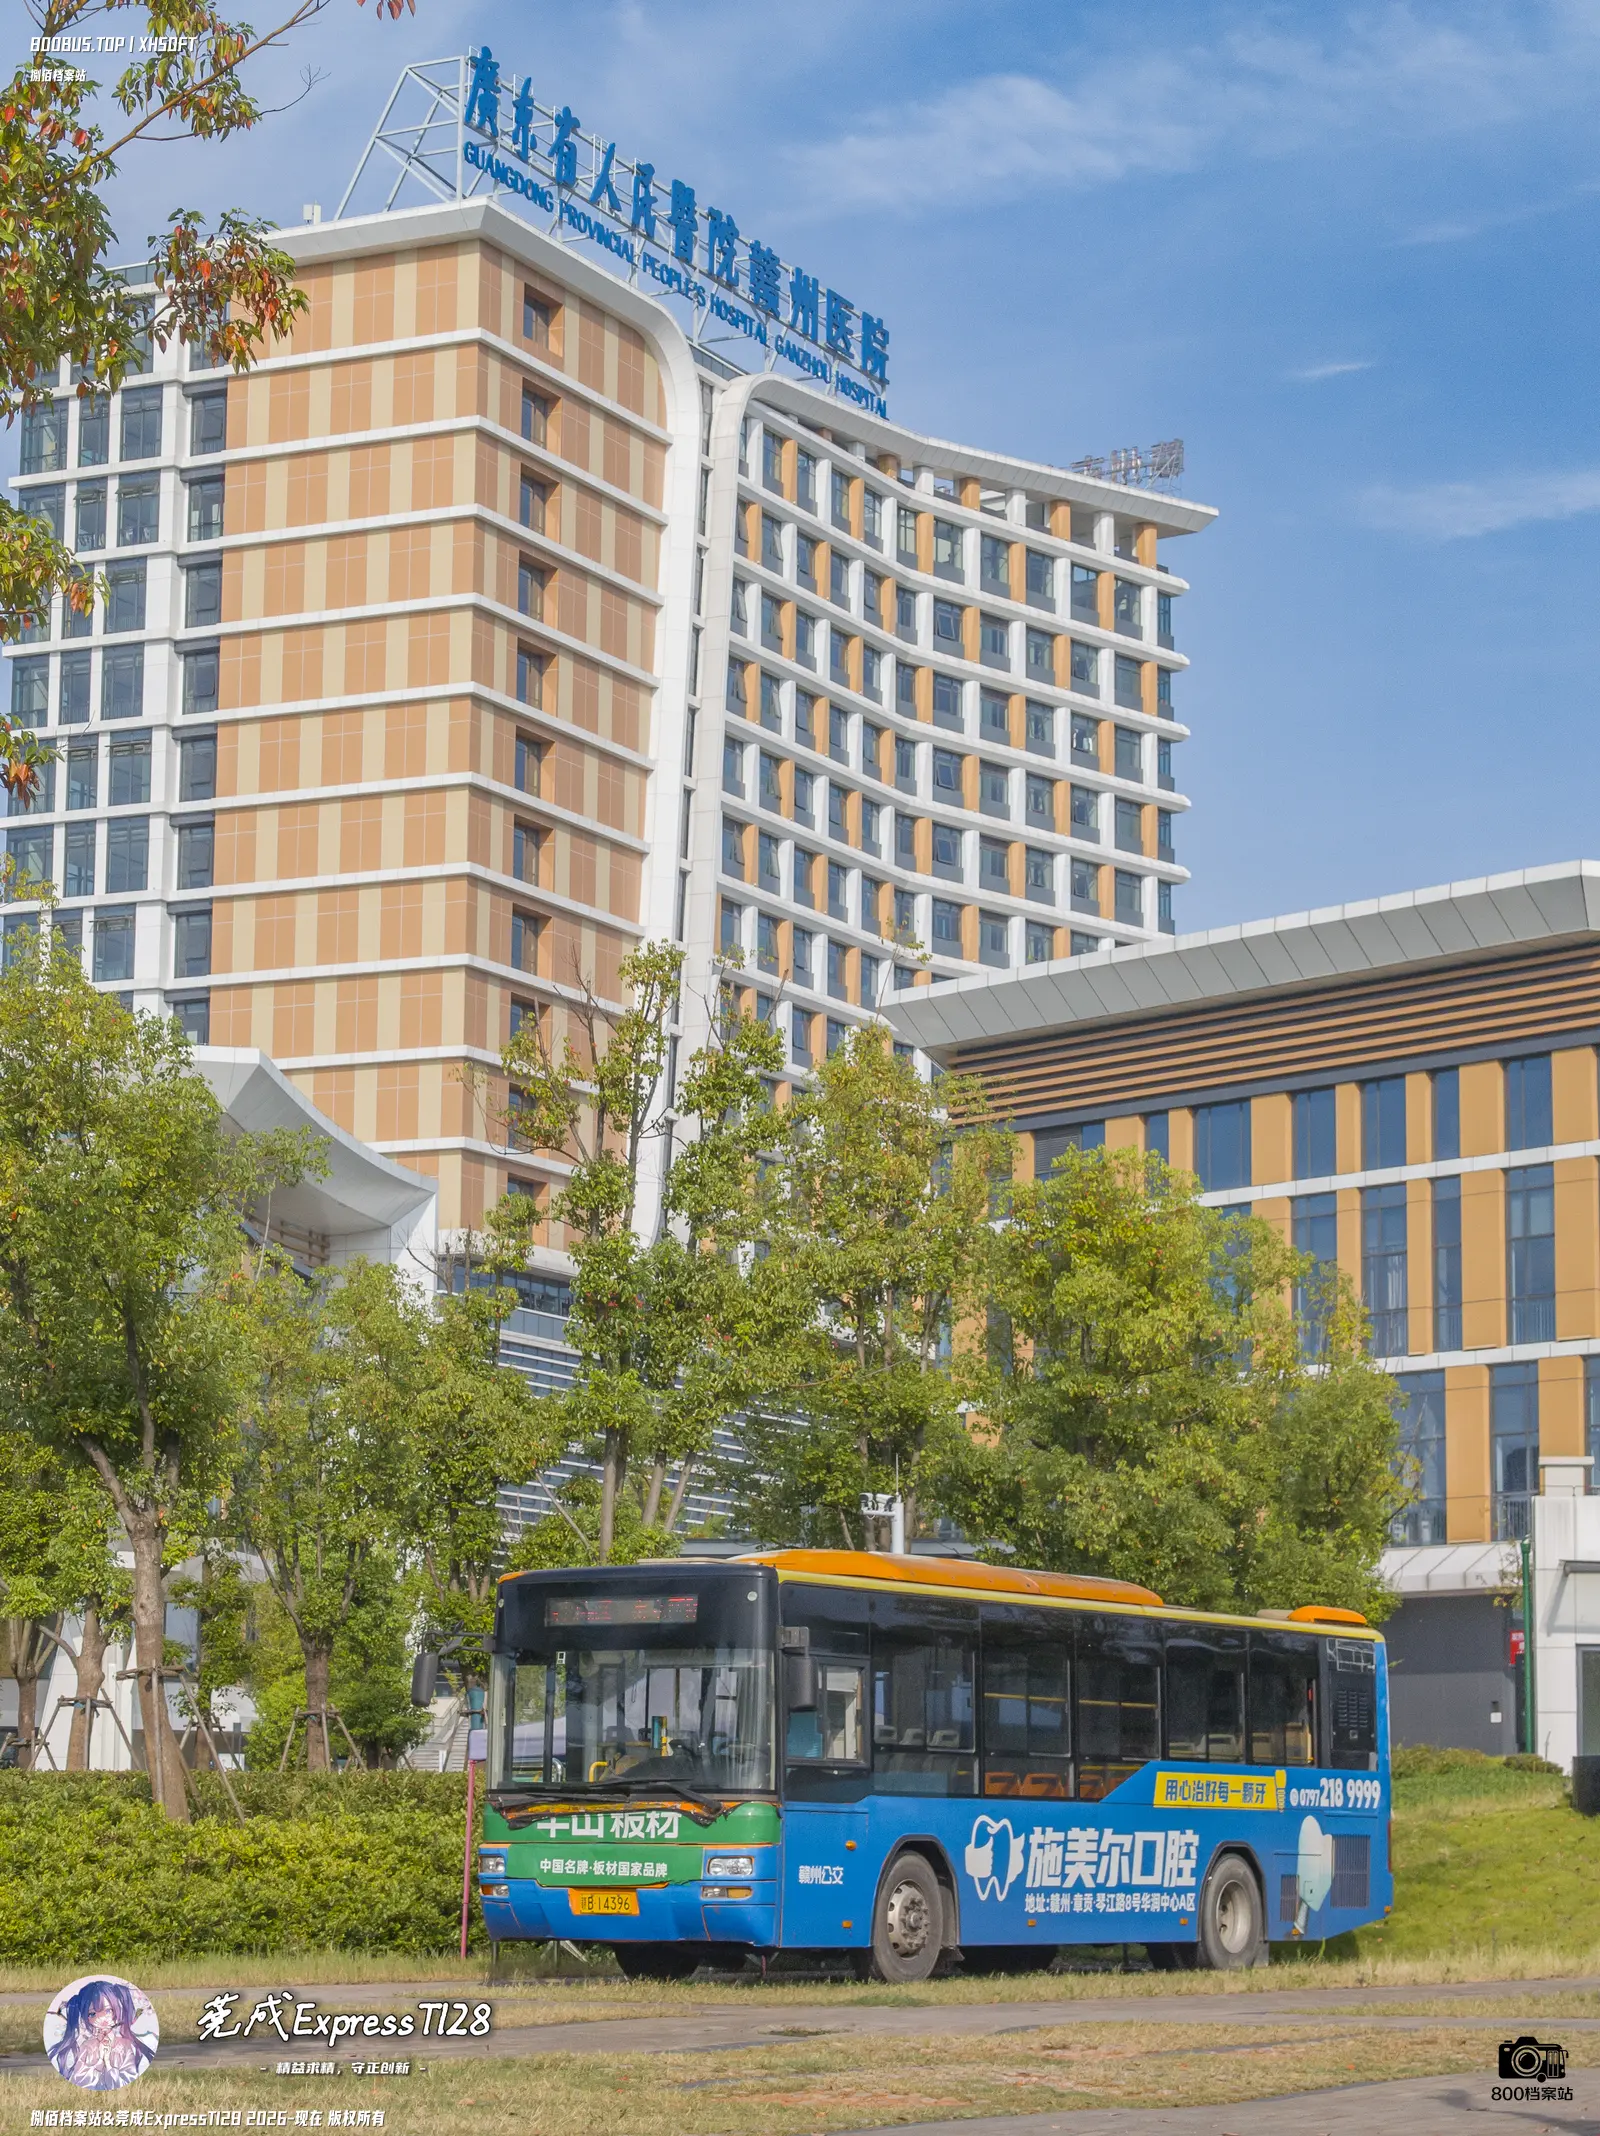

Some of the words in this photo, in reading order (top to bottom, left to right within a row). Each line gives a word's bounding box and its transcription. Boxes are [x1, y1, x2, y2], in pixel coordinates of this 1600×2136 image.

[463, 140, 554, 213] GUANGDONG
[559, 199, 639, 267] PROVINCIAL
[642, 251, 706, 307] PEOPLE'S
[709, 292, 768, 345] HOSPITAL
[774, 334, 833, 384] GANZHOU
[835, 370, 889, 421] HOSPITAL
[1165, 1779, 1267, 1804] 用心治好每一颗牙
[798, 1865, 844, 1885] 赣州公交
[1025, 1826, 1200, 1888] 施美尔口腔
